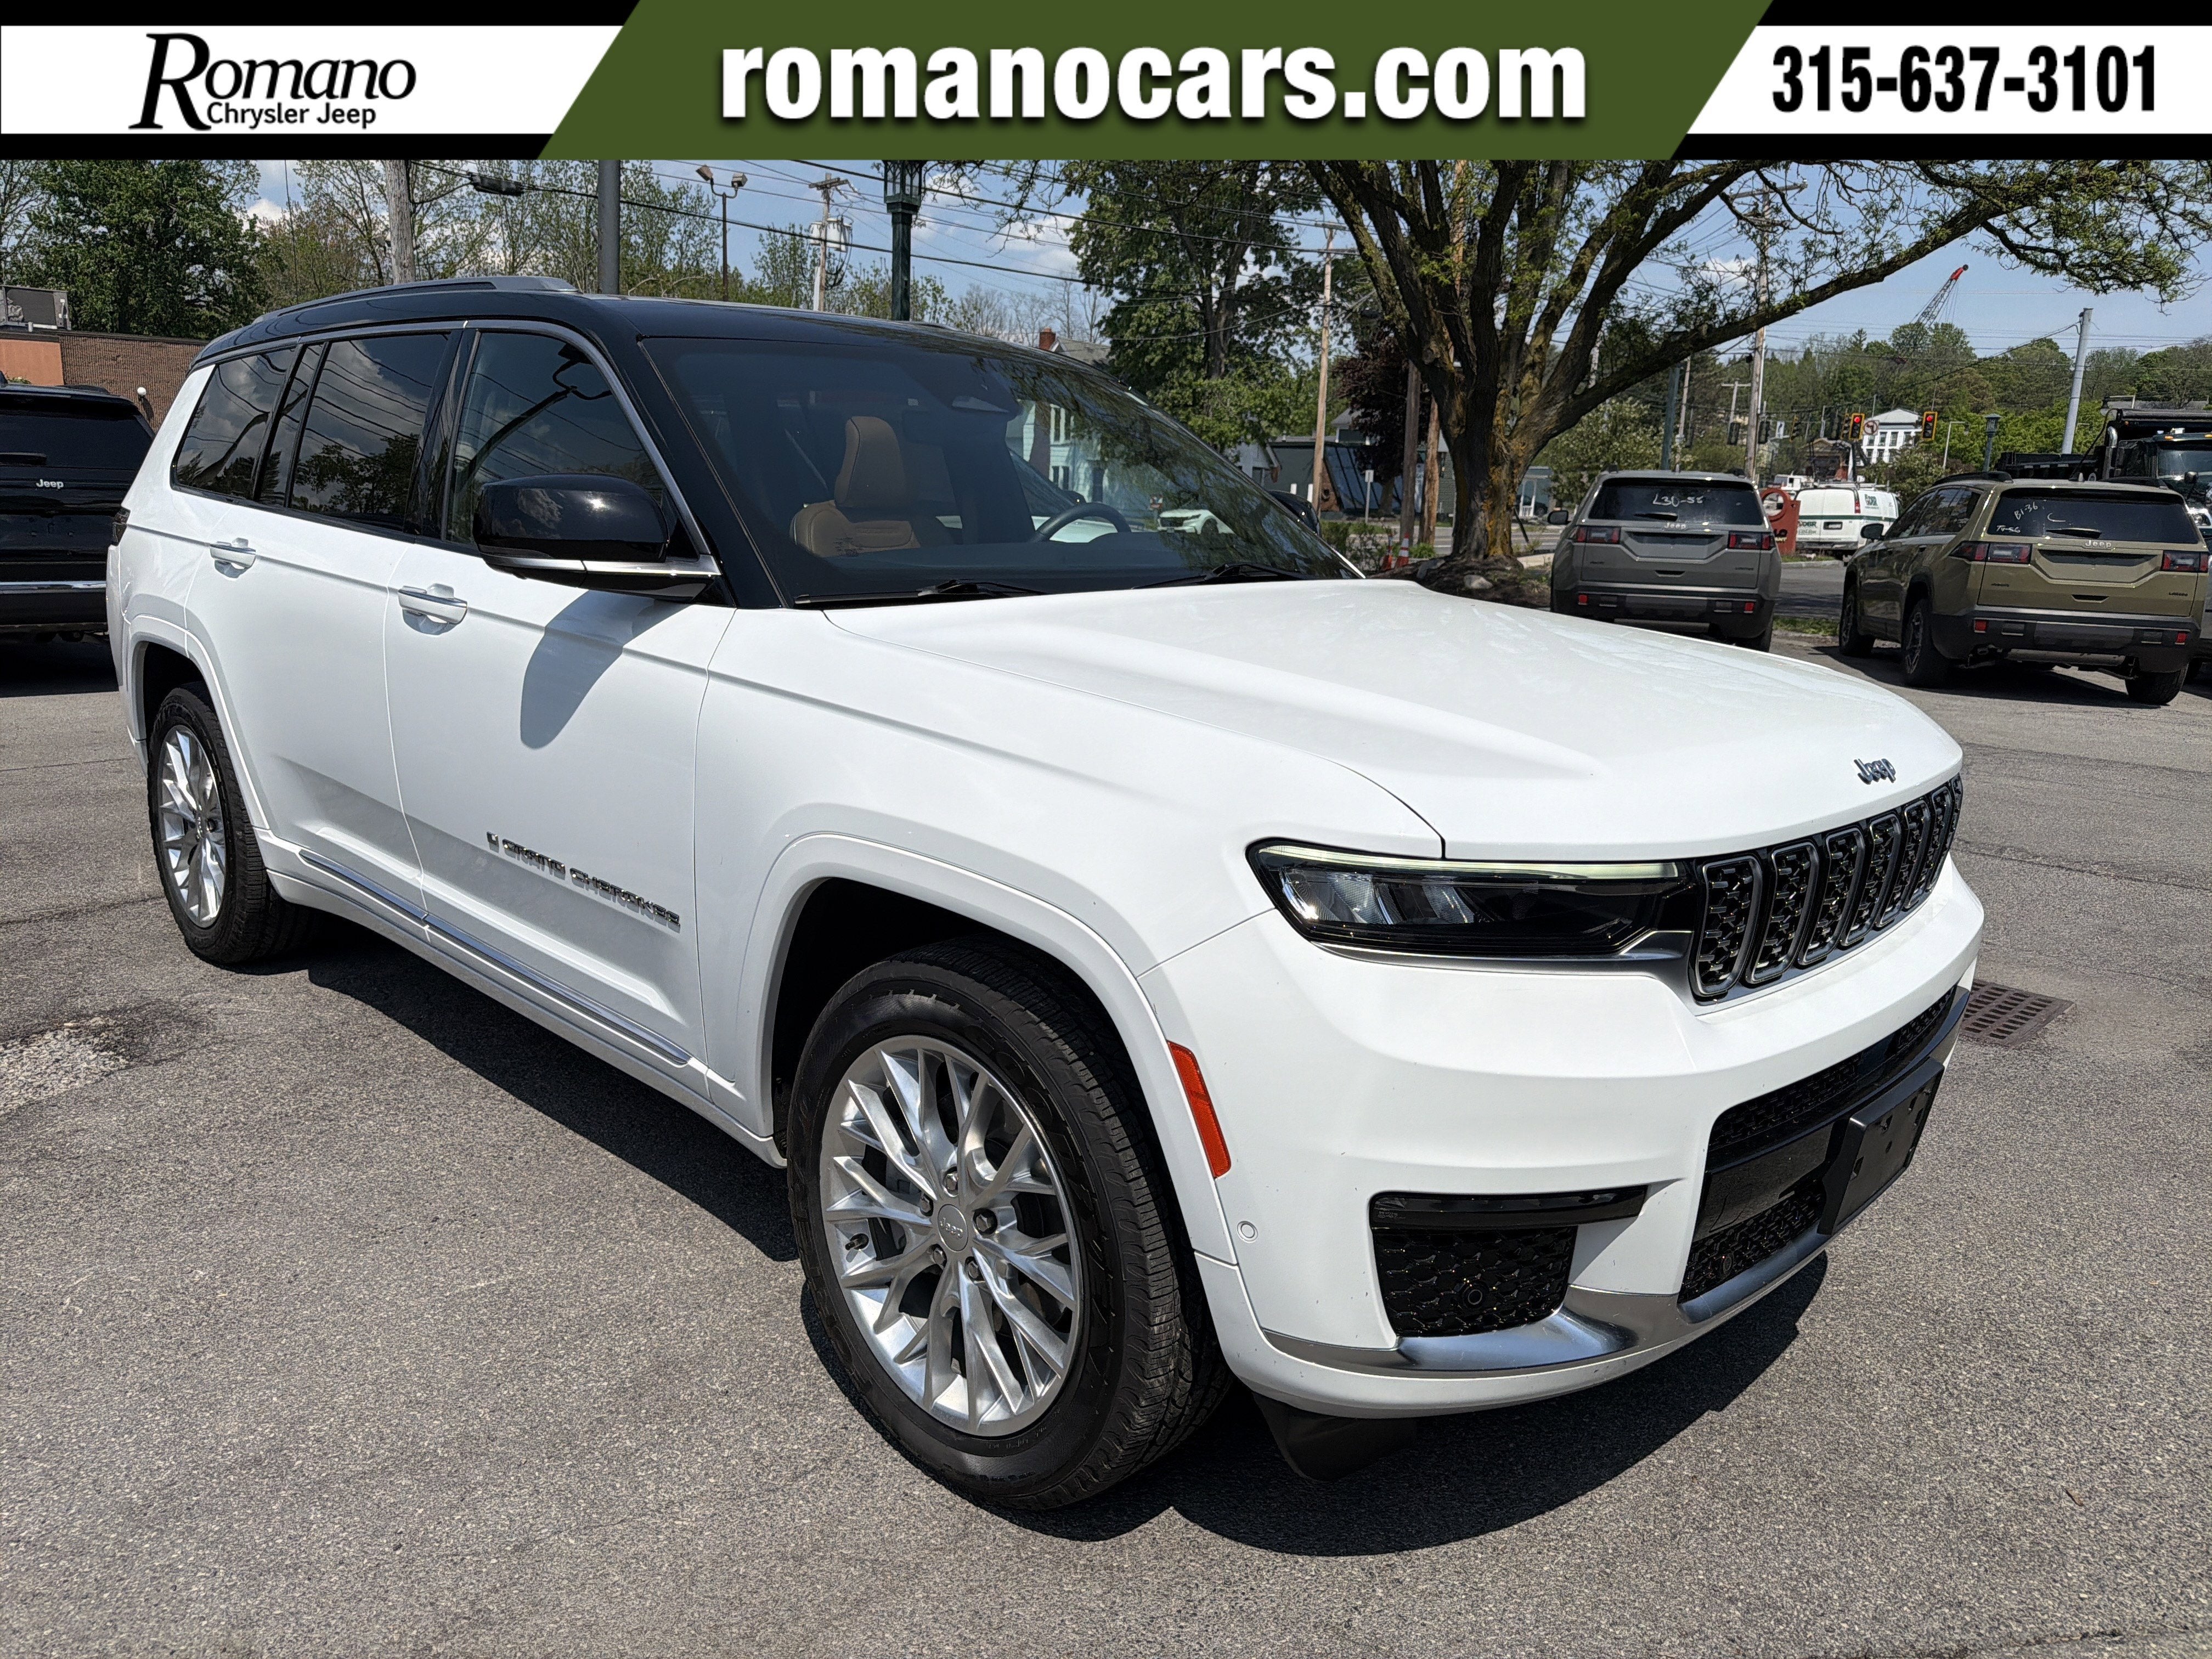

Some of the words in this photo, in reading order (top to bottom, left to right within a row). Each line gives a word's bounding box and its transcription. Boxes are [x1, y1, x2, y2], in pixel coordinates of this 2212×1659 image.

[36, 478, 64, 490] Jeep
[2085, 539, 2112, 549] Jeep
[1853, 758, 1897, 785] Jeep
[569, 867, 680, 926] CHEROKEE
